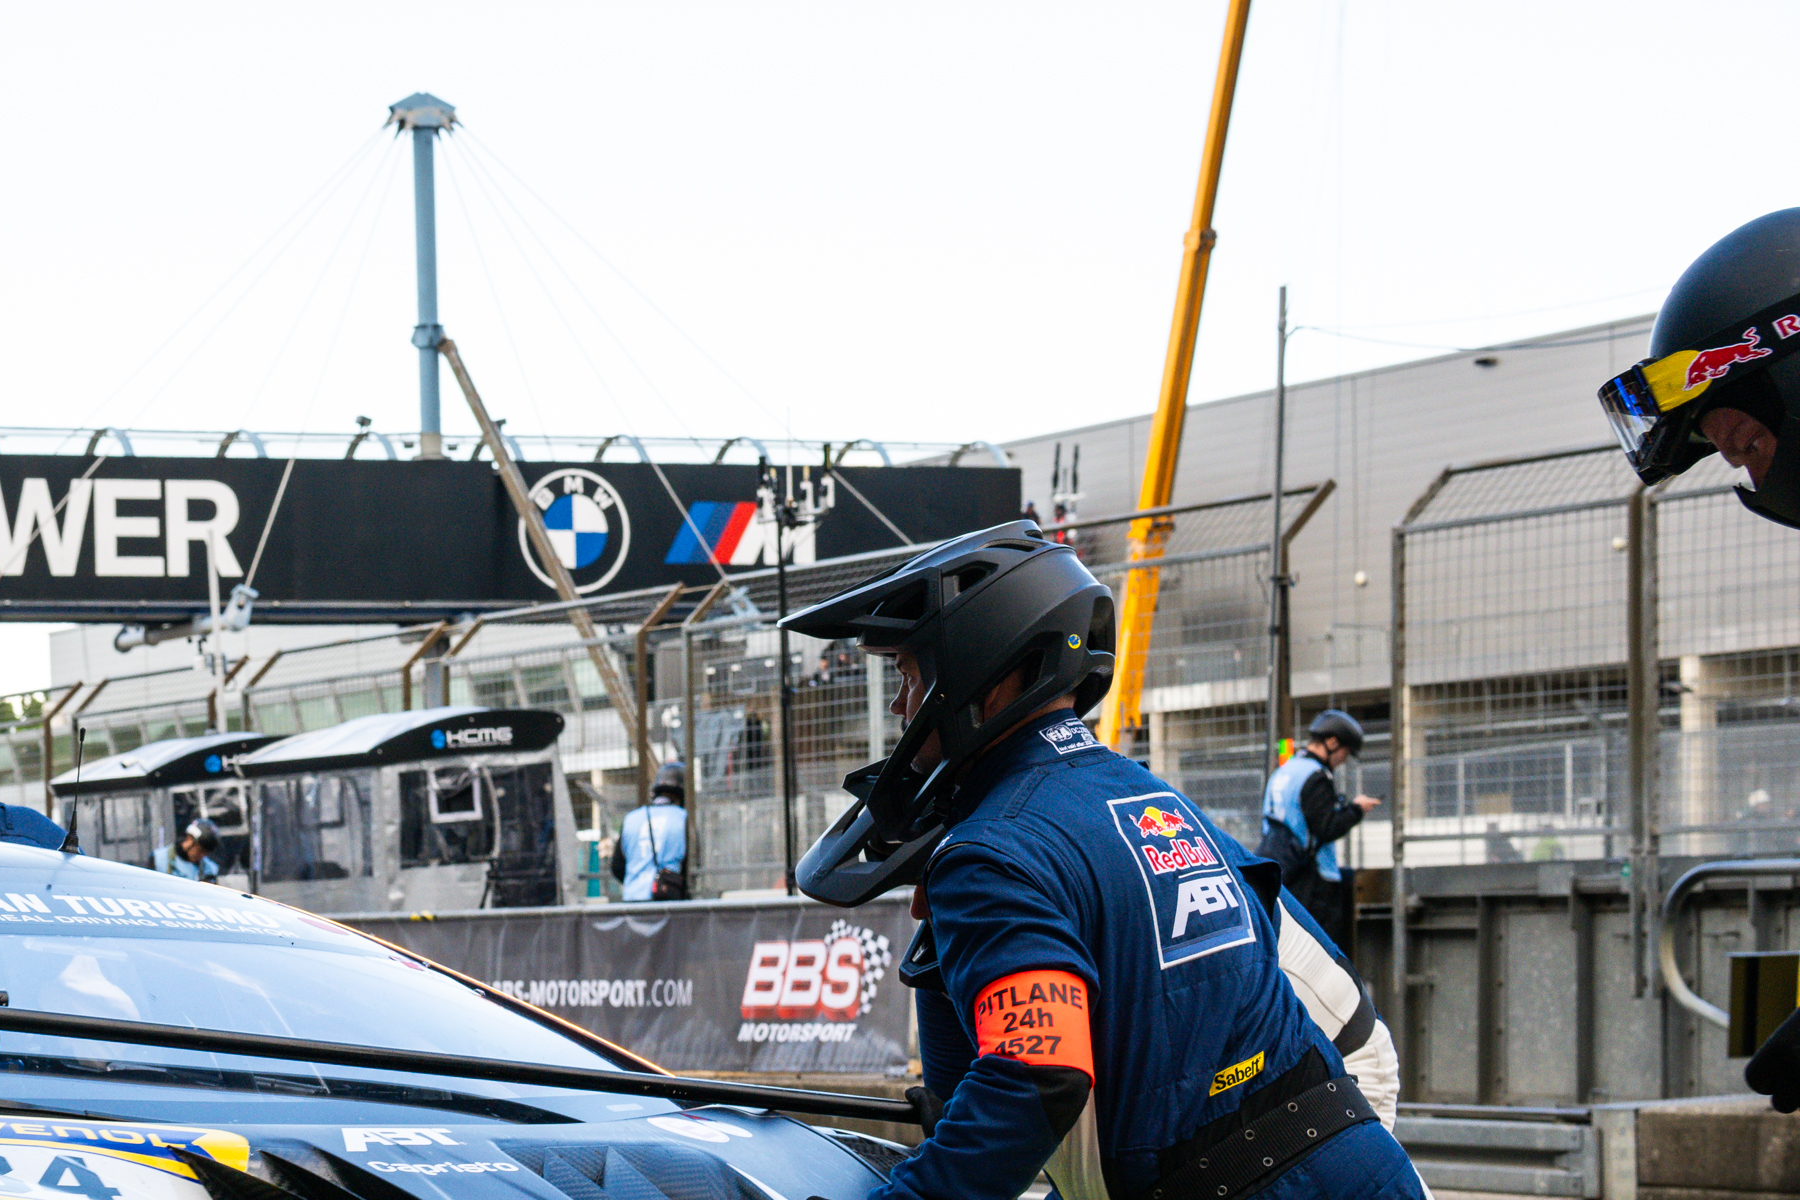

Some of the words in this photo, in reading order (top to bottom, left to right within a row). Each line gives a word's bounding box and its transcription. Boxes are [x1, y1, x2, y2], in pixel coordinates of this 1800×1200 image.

[534, 475, 615, 511] BMW
[1141, 838, 1190, 875] Red
[1177, 836, 1218, 867] Bull
[52, 894, 281, 929] TURISMO
[54, 915, 159, 927] DRIVING
[1172, 874, 1239, 938] ABT
[741, 938, 864, 1017] BBS
[978, 982, 1082, 1026] PITLANE
[1003, 1007, 1054, 1034] 24h
[738, 1022, 858, 1042] MOTORSPORT
[1214, 1058, 1260, 1090] Sabelt
[341, 1127, 460, 1152] ABT
[367, 1161, 519, 1176] Capristo
